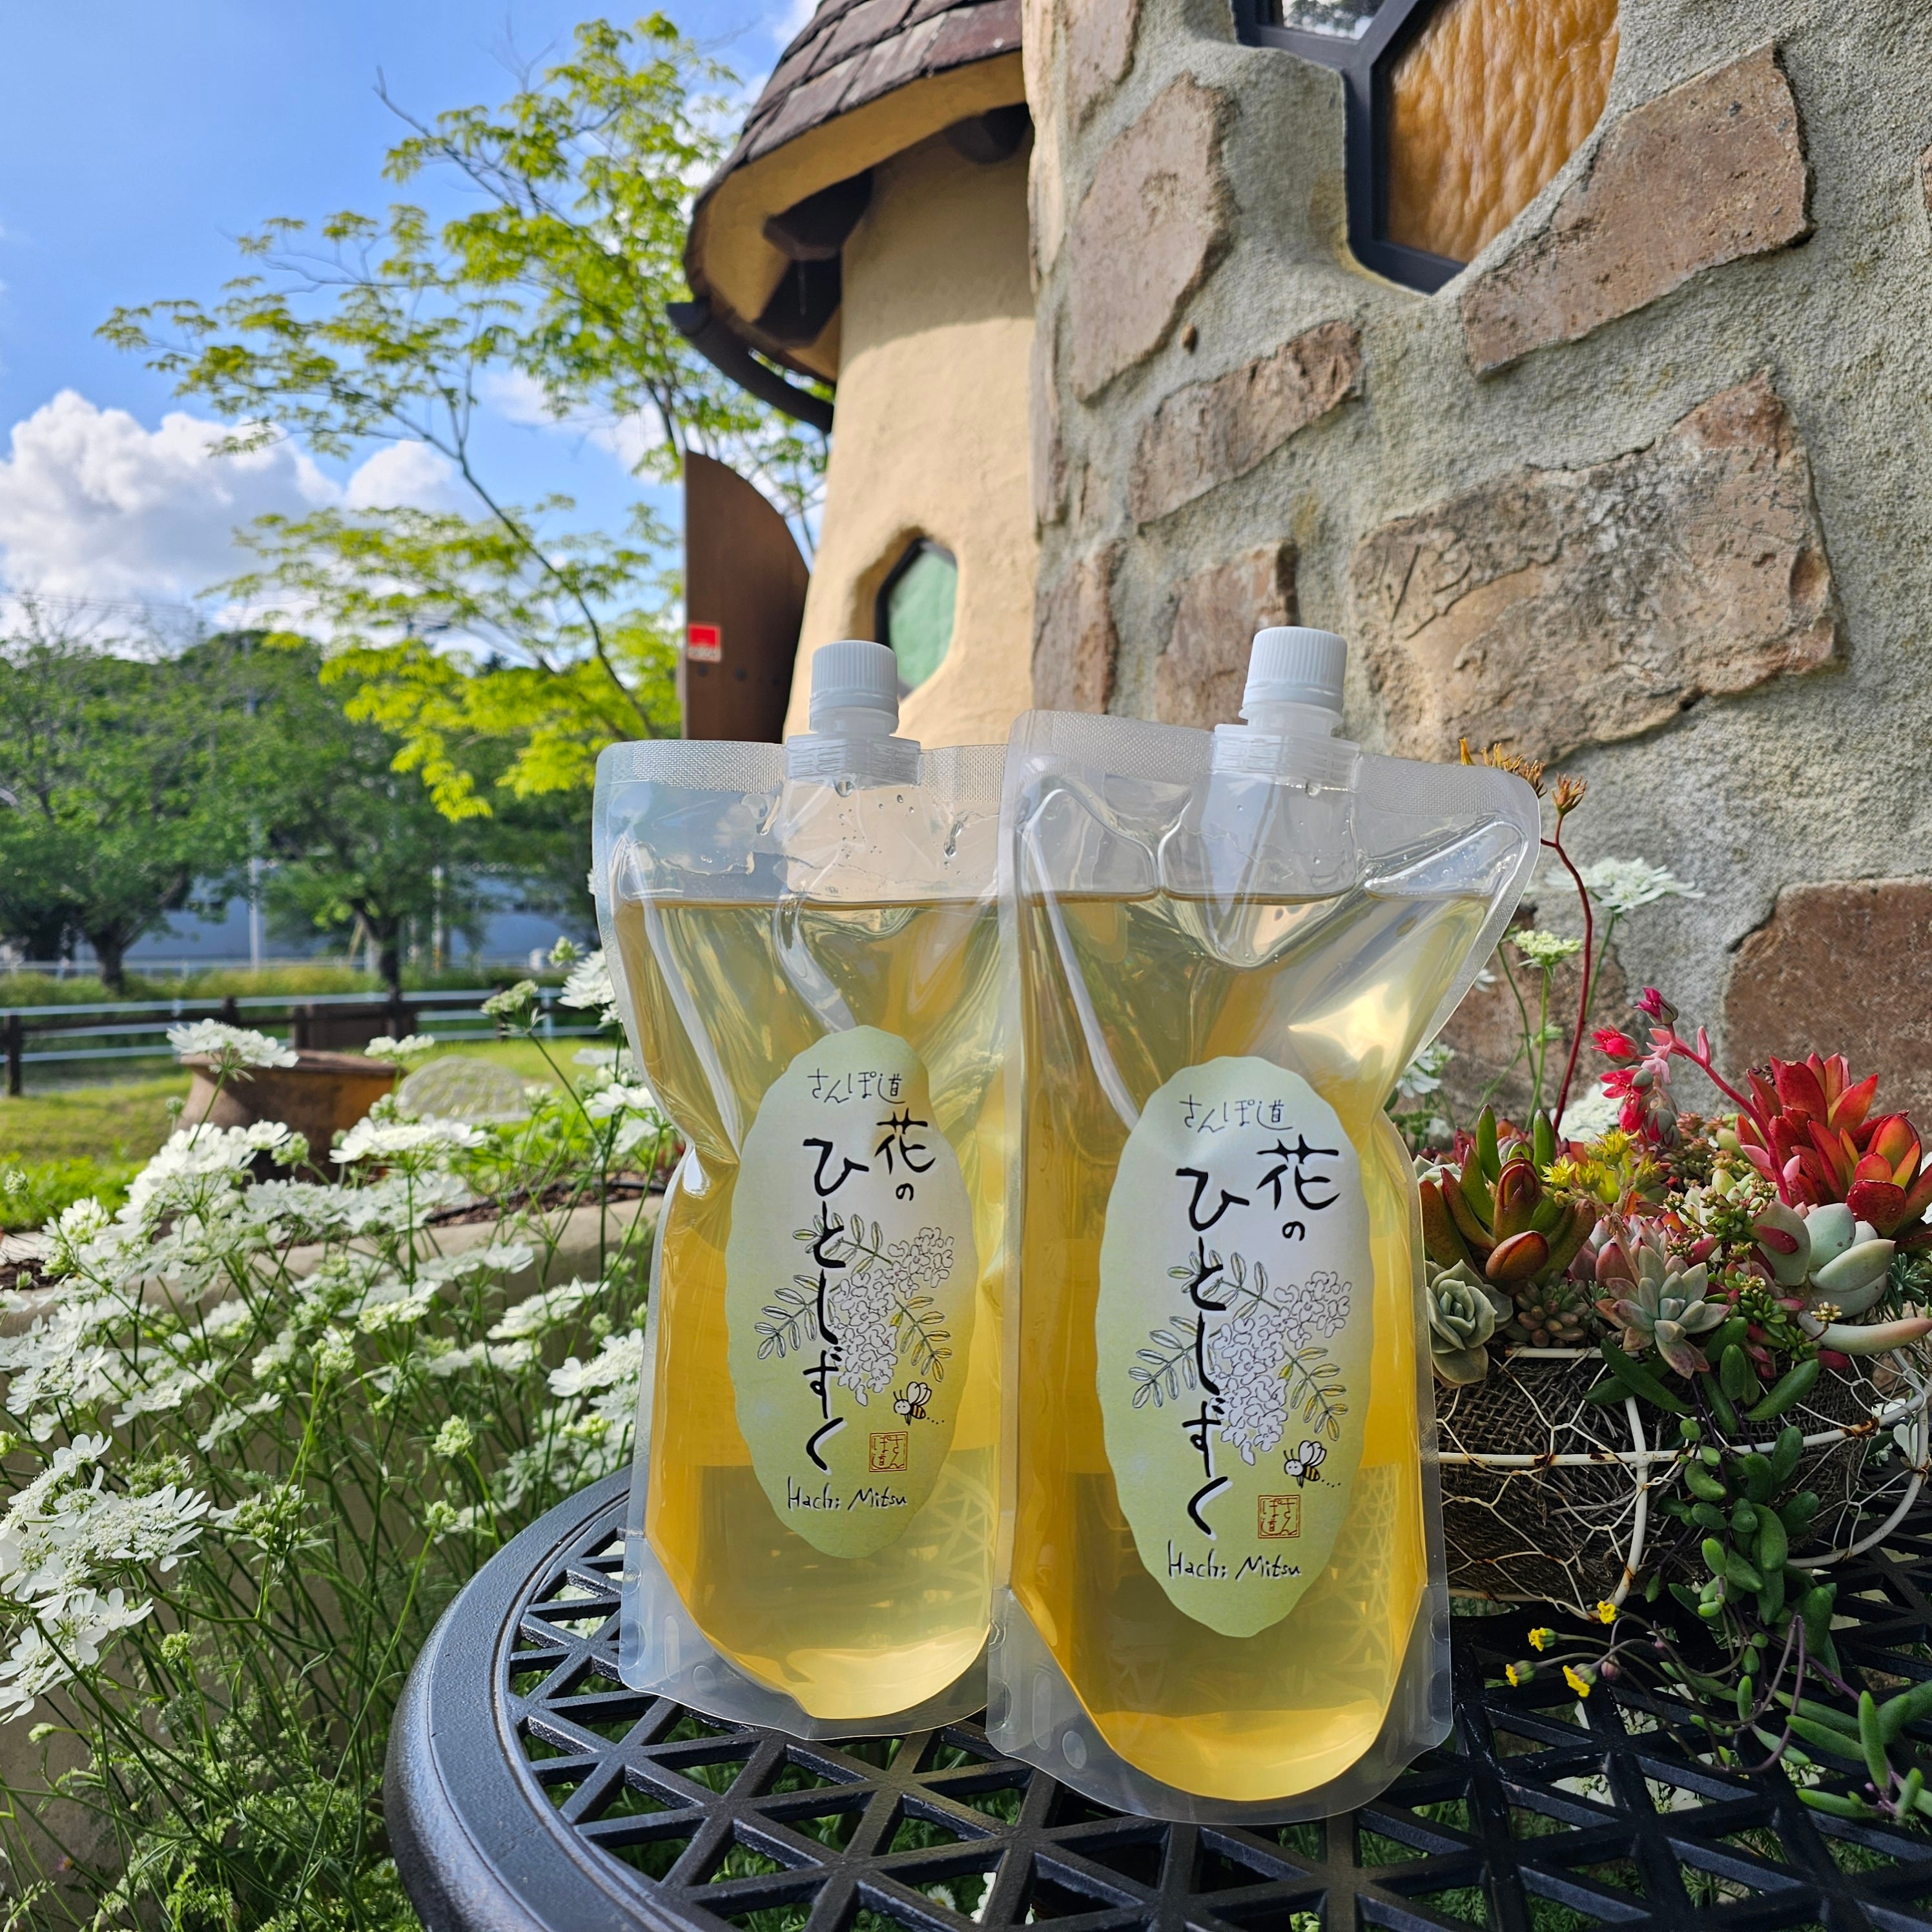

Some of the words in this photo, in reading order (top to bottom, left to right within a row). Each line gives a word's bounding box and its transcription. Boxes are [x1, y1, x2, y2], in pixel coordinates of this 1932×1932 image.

[807, 1068, 906, 1104] さんぽ道
[1179, 1094, 1293, 1133] さんぽ道
[874, 1107, 936, 1201] 花の
[1256, 1133, 1341, 1242] 花の
[803, 1137, 870, 1471] ひとしずく
[1175, 1167, 1250, 1537] ひとしずく
[787, 1476, 840, 1510] Hachi
[847, 1486, 907, 1511] Mitsu
[1167, 1539, 1227, 1577] Hachi
[1235, 1554, 1300, 1581] Mitsu
